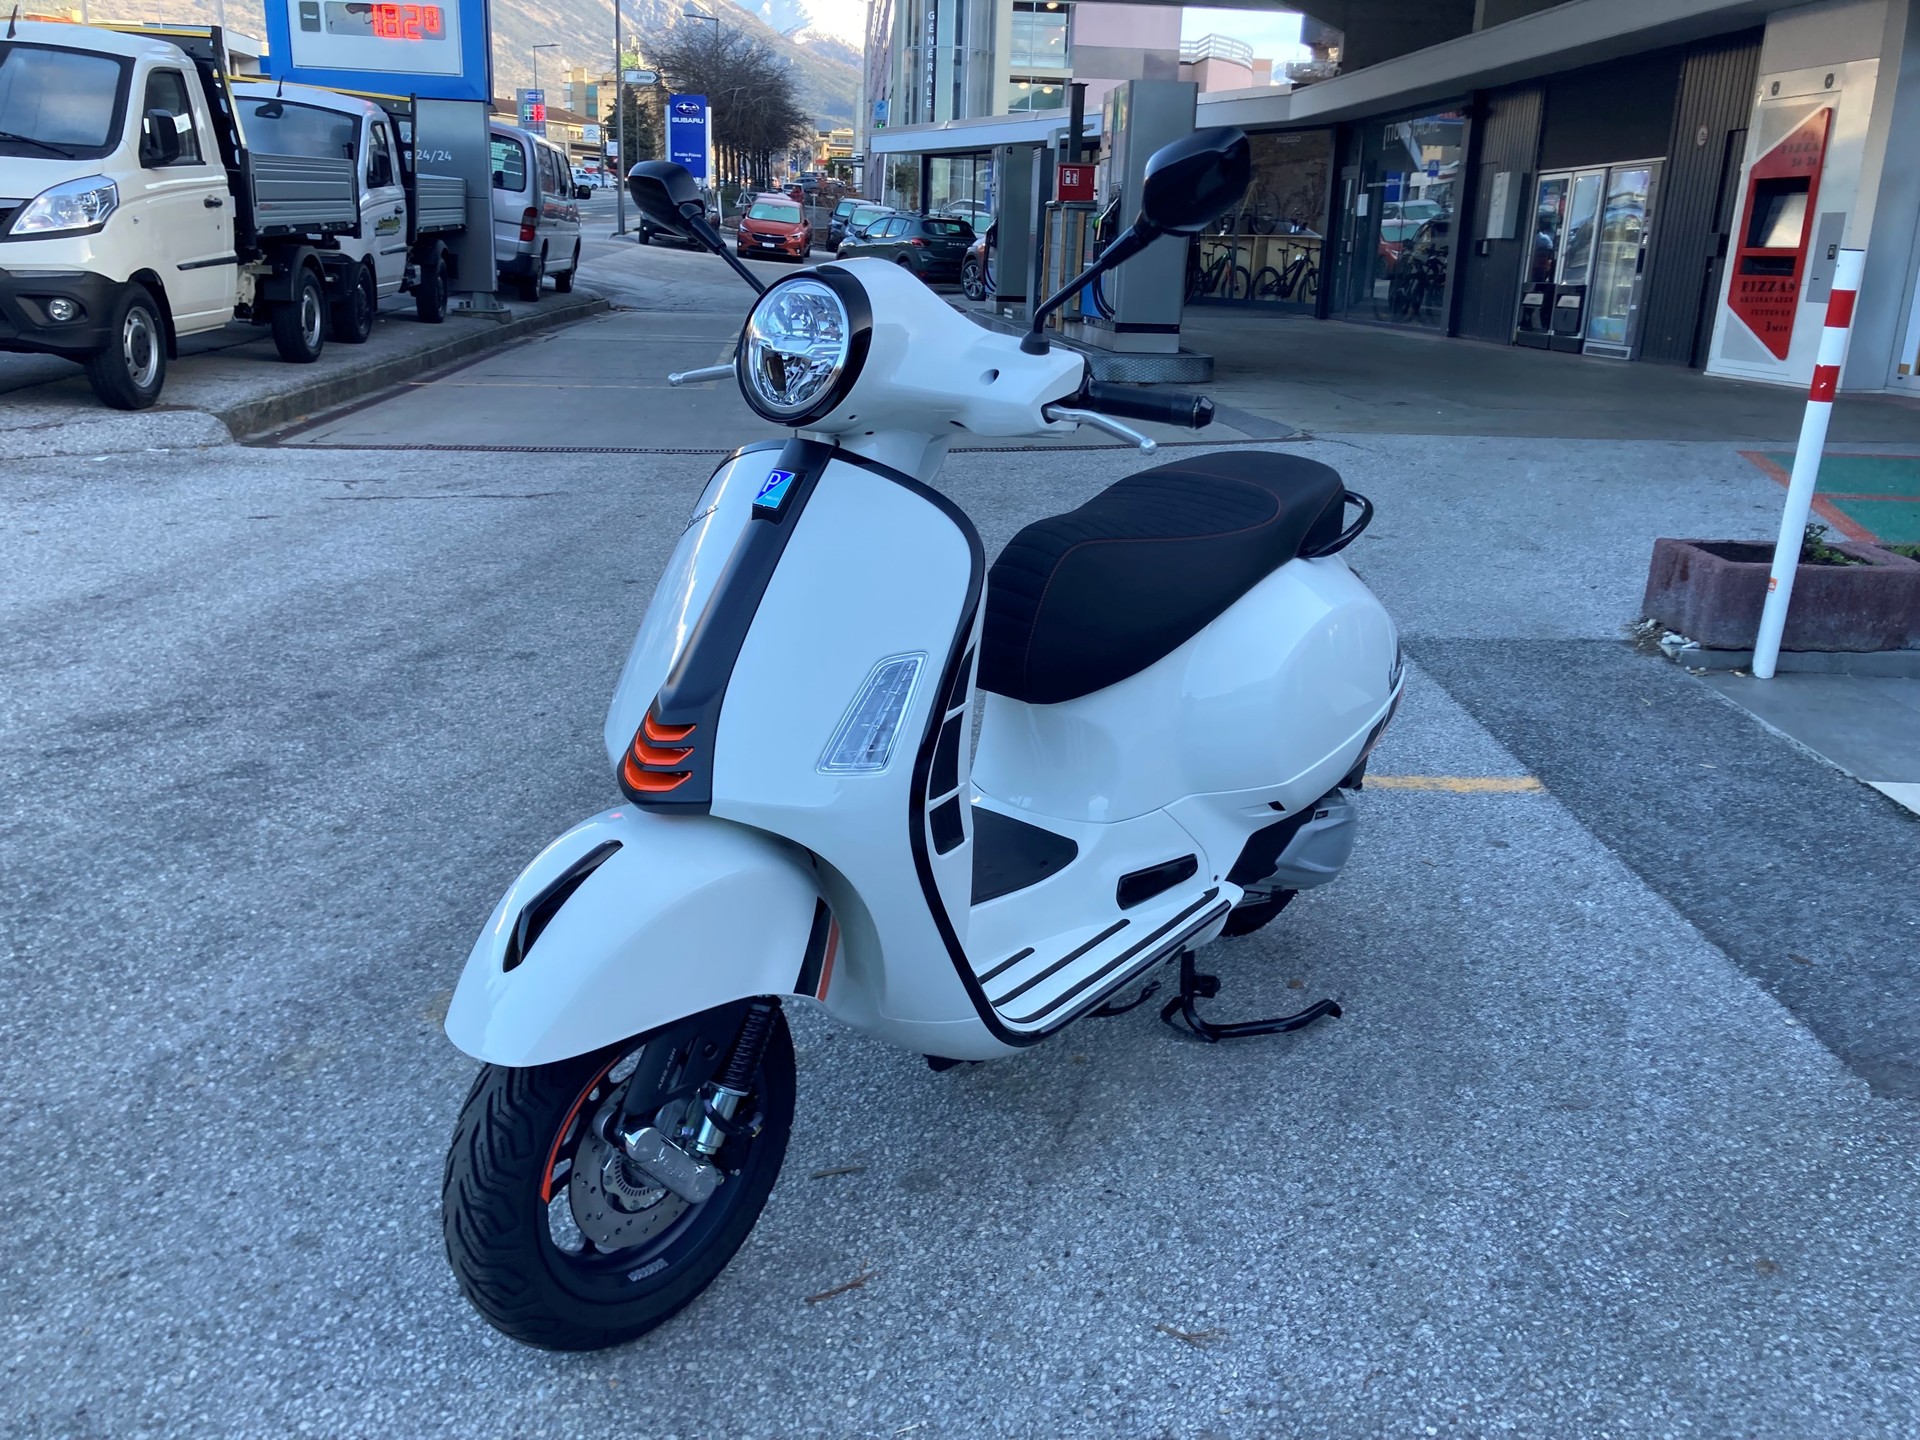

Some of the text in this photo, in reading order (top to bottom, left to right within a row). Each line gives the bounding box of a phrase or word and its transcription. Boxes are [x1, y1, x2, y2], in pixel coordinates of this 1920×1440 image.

[926, 11, 935, 108] GÉNÉRALE
[416, 149, 452, 163] 24/24
[1006, 146, 1013, 155] 4
[1741, 280, 1796, 293] PIZZAS
